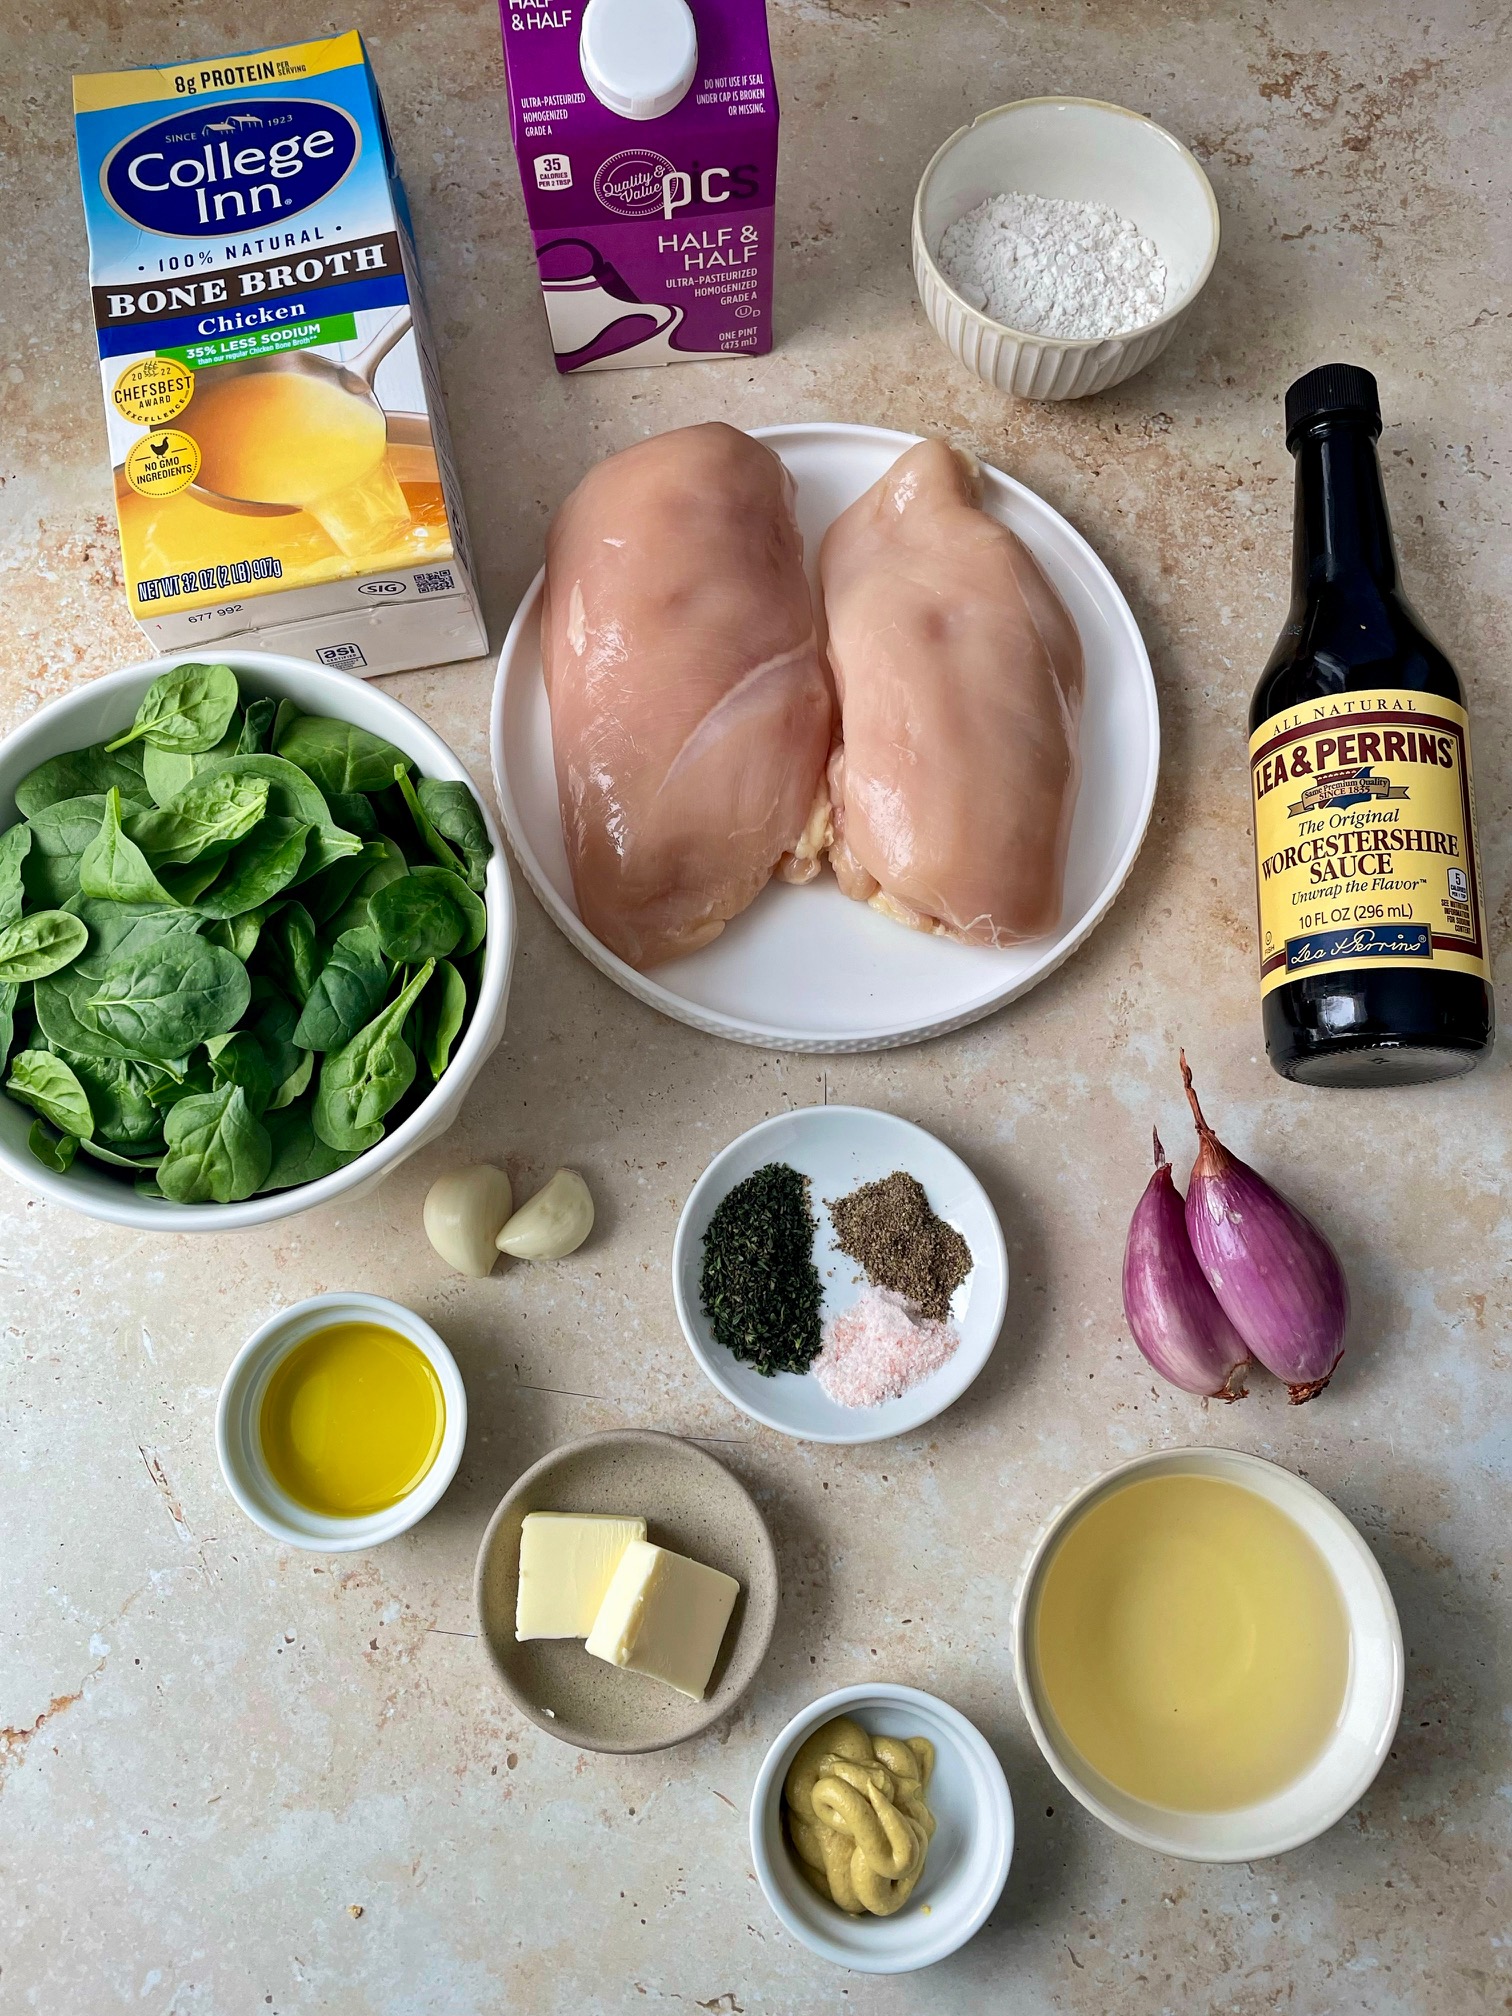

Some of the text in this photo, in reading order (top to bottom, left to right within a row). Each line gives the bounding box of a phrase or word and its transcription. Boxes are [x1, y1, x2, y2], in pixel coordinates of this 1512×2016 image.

[512, 10, 572, 31] & HALF
[276, 61, 290, 69] PER
[278, 64, 306, 76] SERVING
[175, 61, 275, 94] 8g PROTEIN
[704, 74, 764, 89] DO NOT USE IF SEAL
[521, 93, 585, 108] ULTRA-PASTEURIZED
[696, 88, 765, 105] UNDER CAP IS BROKEN
[523, 109, 568, 123] HOMOGENIZED
[728, 103, 766, 116] OR MISSING.
[165, 114, 293, 143] SINCE 1923
[525, 125, 552, 137] GRADE A
[128, 130, 334, 192] College
[543, 158, 561, 171] 35
[540, 172, 568, 180] CALORIES
[602, 165, 666, 197] Quality &
[620, 184, 662, 202] Value
[159, 227, 324, 272] 100% NATURAL
[658, 225, 758, 253] HALF &
[685, 245, 758, 271] HALF
[107, 244, 387, 318] BONE BROTH
[666, 268, 757, 288] ULTRA-PASTEURIZED
[694, 280, 757, 297] HOMOGENIZED
[721, 291, 757, 305] GRADE A
[198, 303, 306, 335] Chicken
[186, 324, 320, 360] 35% LESS SODIUM
[719, 327, 757, 341] ONE PINT
[721, 336, 757, 350] (473 mL)
[198, 357, 212, 365] than
[226, 350, 248, 361] regular
[249, 345, 274, 355] Chicken
[275, 341, 291, 350] Bone
[114, 376, 191, 404] CHEFSBEST
[125, 399, 185, 421] EXCELLENCE
[139, 395, 170, 409] AWARD
[137, 464, 192, 485] INGREDIENTS
[145, 456, 180, 472] NO GMO
[138, 557, 282, 602] NET WT 32 OZ (2 LB) 907g
[367, 584, 397, 593] SIG
[188, 605, 244, 623] 677 992
[323, 646, 355, 658] asi
[1274, 699, 1416, 735] ALL NATURAL
[1305, 778, 1388, 799] Same Premium Quality
[1319, 788, 1346, 800] SINCE
[1299, 808, 1400, 837] The Original
[1262, 829, 1460, 881] WORCESTERSHIRE
[1310, 853, 1394, 885] SAUCE
[1455, 873, 1461, 885] 5
[1292, 884, 1342, 906] Unwrap
[1346, 879, 1367, 892] the
[1299, 903, 1413, 929] 10 FL OZ (296 mL)
[1291, 943, 1326, 965] Lea
